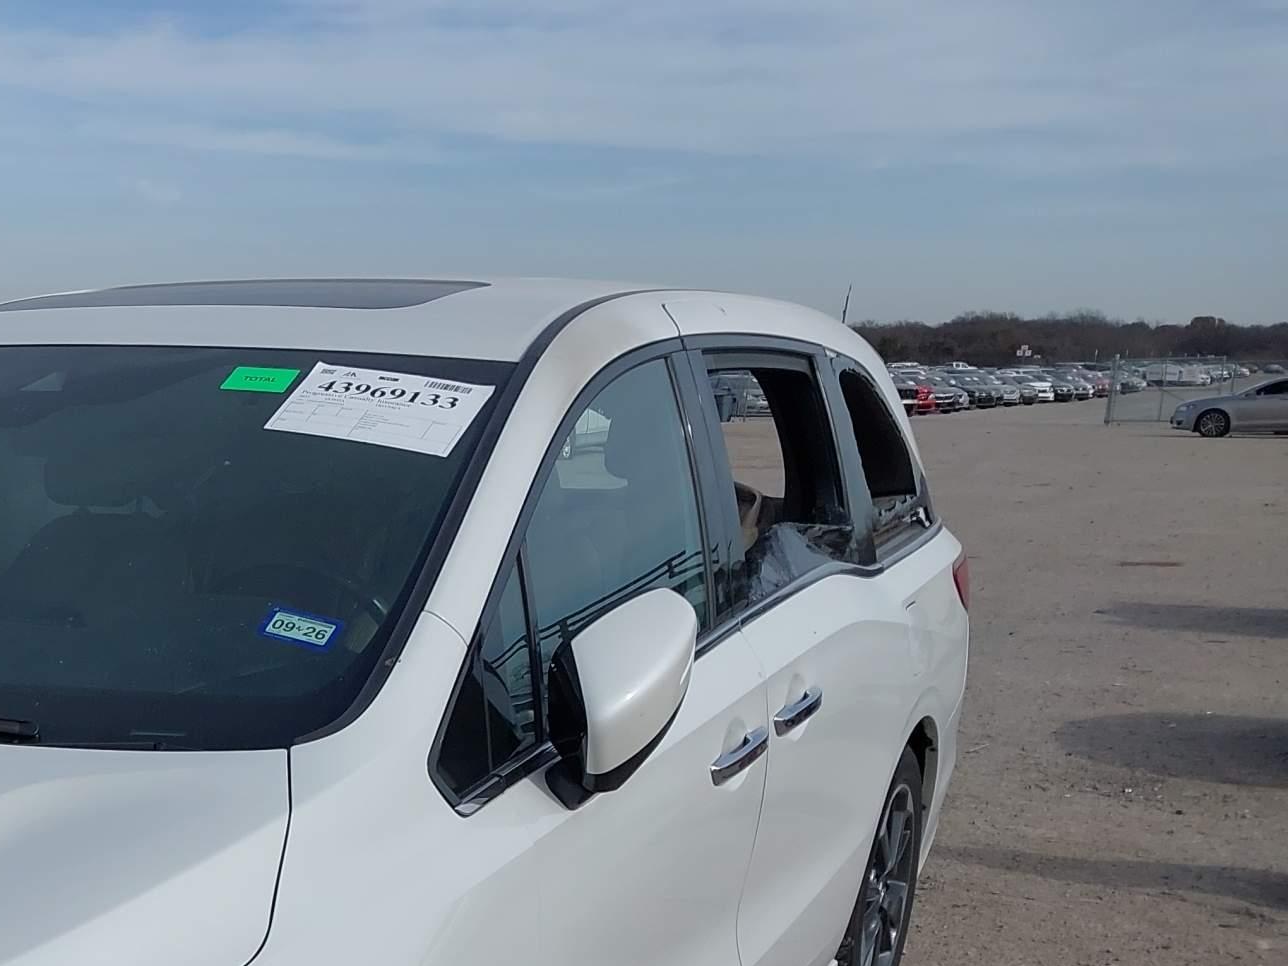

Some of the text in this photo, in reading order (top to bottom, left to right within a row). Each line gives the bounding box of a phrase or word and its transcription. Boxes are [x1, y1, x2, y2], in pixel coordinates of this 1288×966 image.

[317, 380, 459, 409] 43969133
[272, 619, 295, 632] 09
[302, 626, 328, 640] 26
